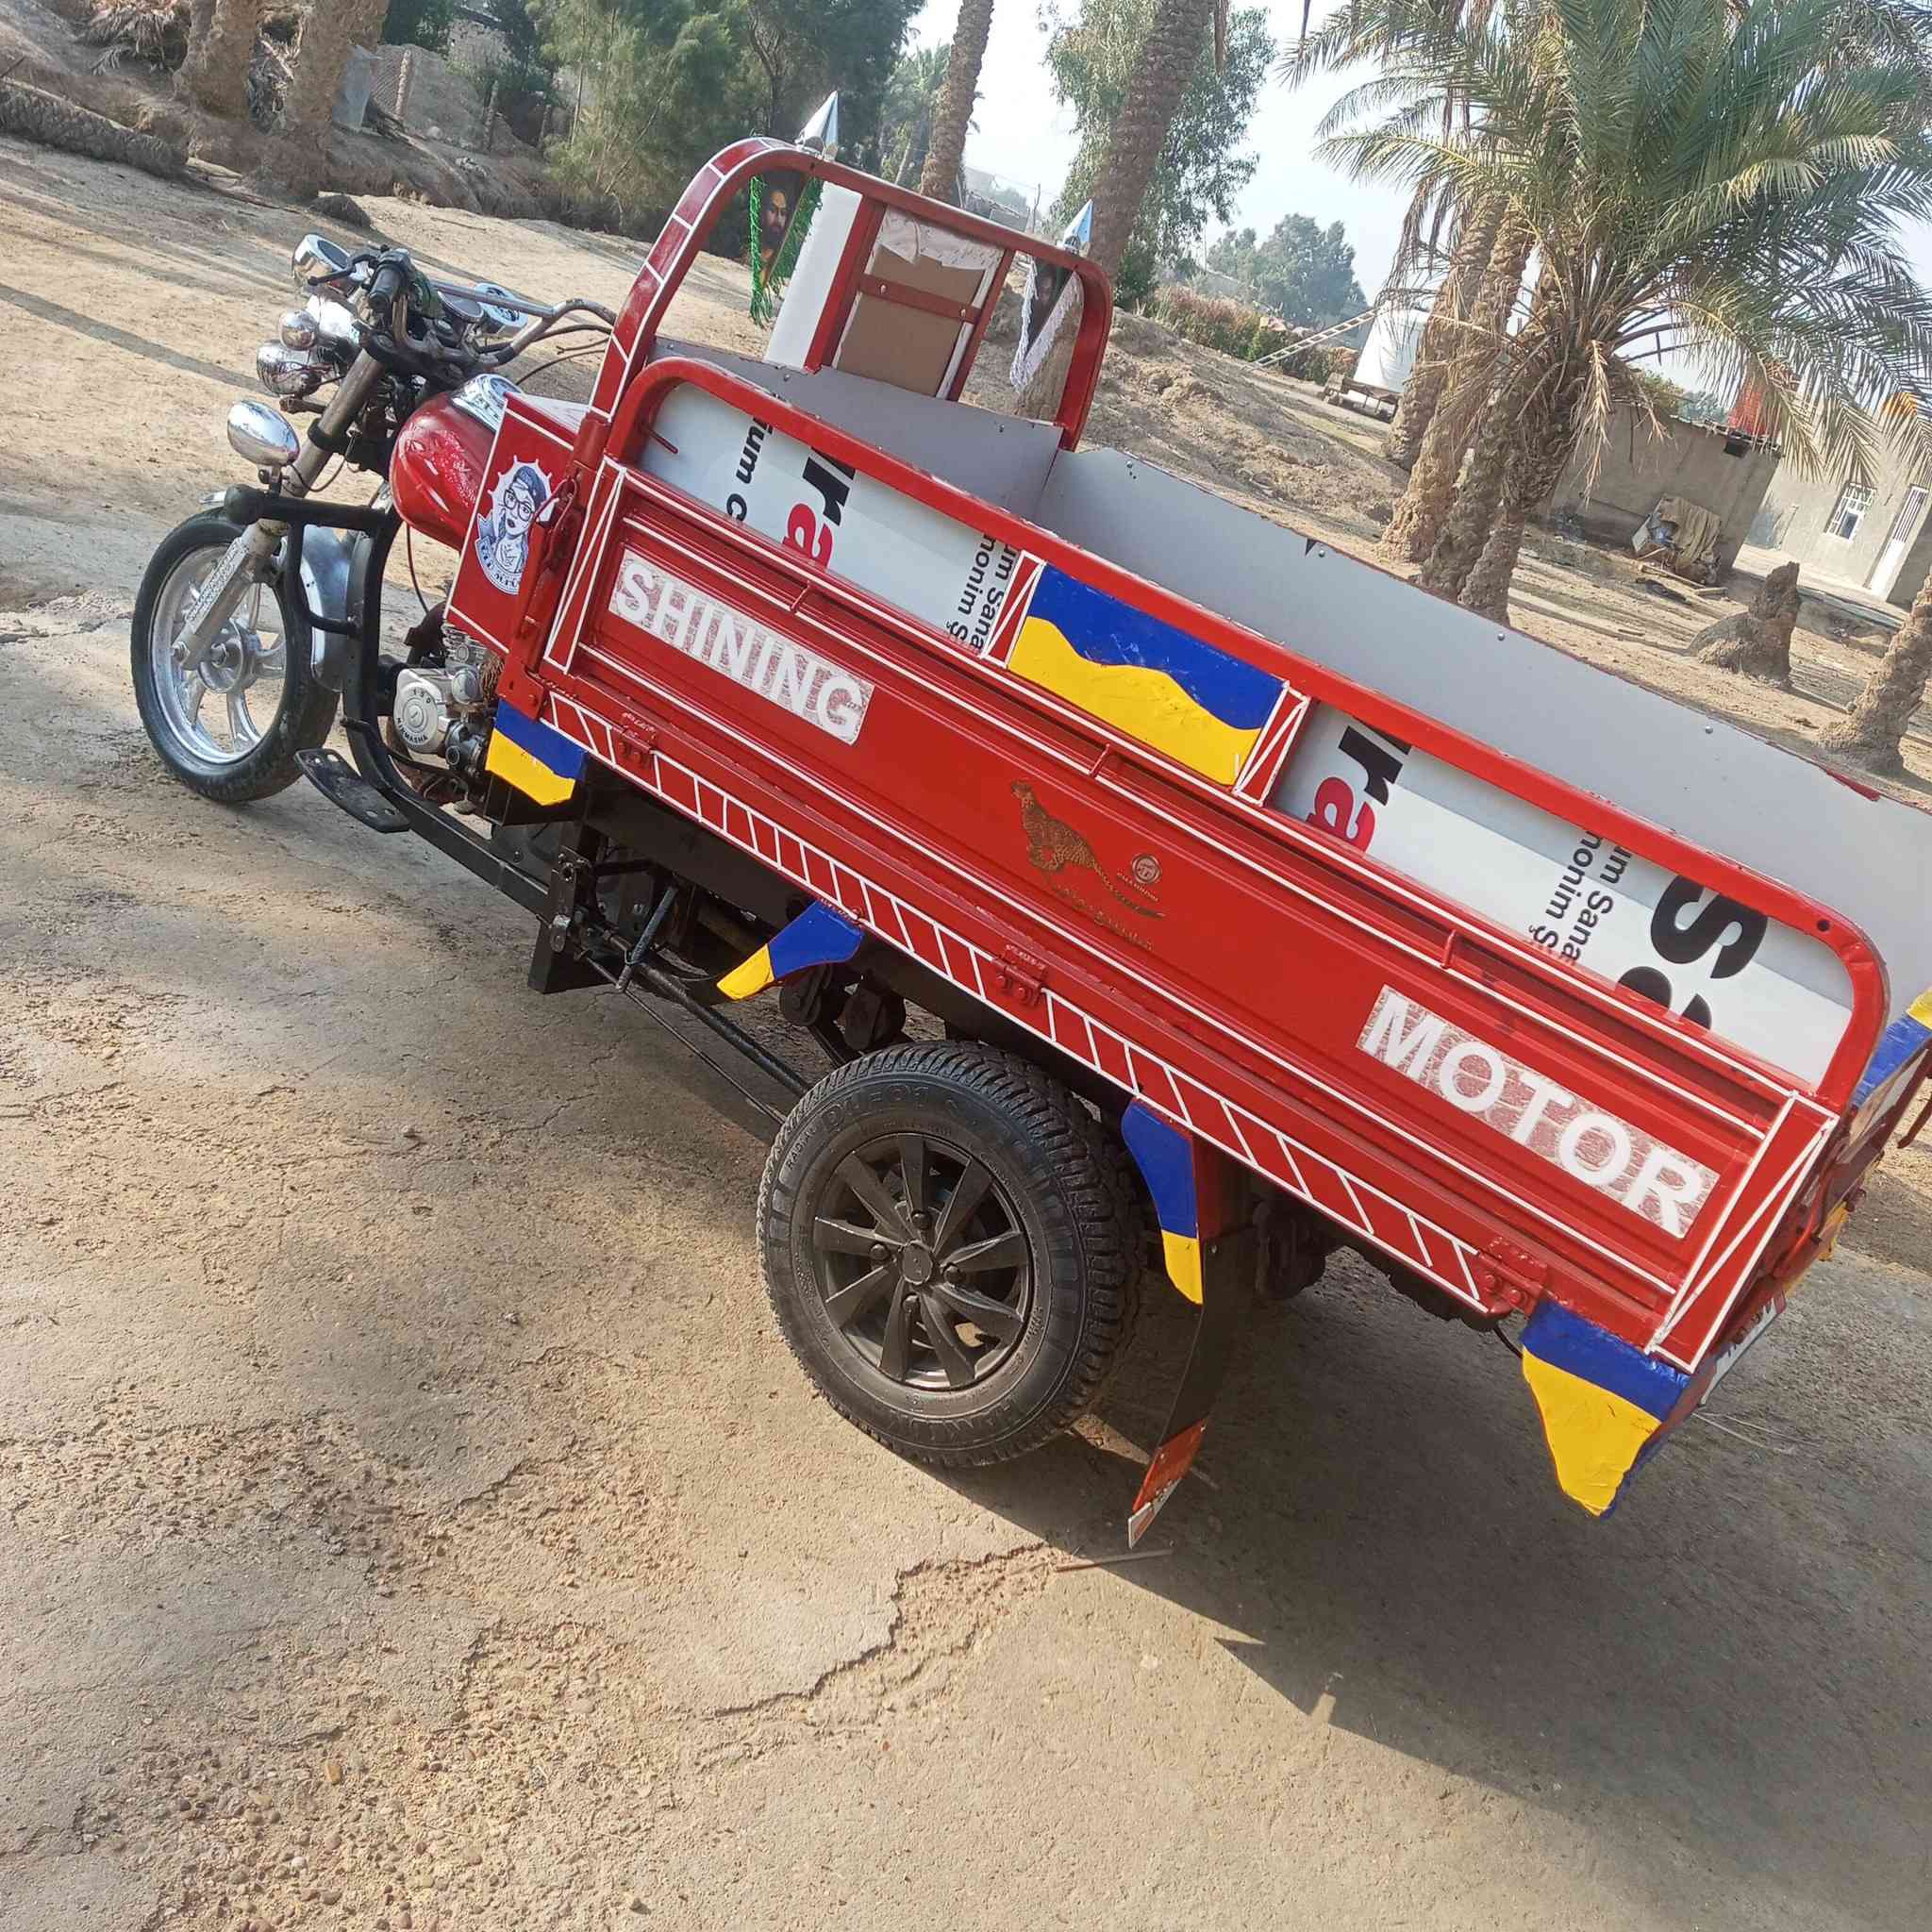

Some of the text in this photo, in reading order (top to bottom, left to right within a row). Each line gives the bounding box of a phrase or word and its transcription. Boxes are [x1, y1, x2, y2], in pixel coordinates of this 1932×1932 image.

[781, 447, 856, 570] ra
[958, 534, 996, 615] nonim
[970, 587, 1005, 649] Sana
[615, 562, 863, 739] SHINING
[1305, 716, 1412, 853] ra
[1545, 830, 1604, 920] nonim
[1561, 890, 1614, 962] Sana
[1362, 991, 1702, 1239] MOTOR
